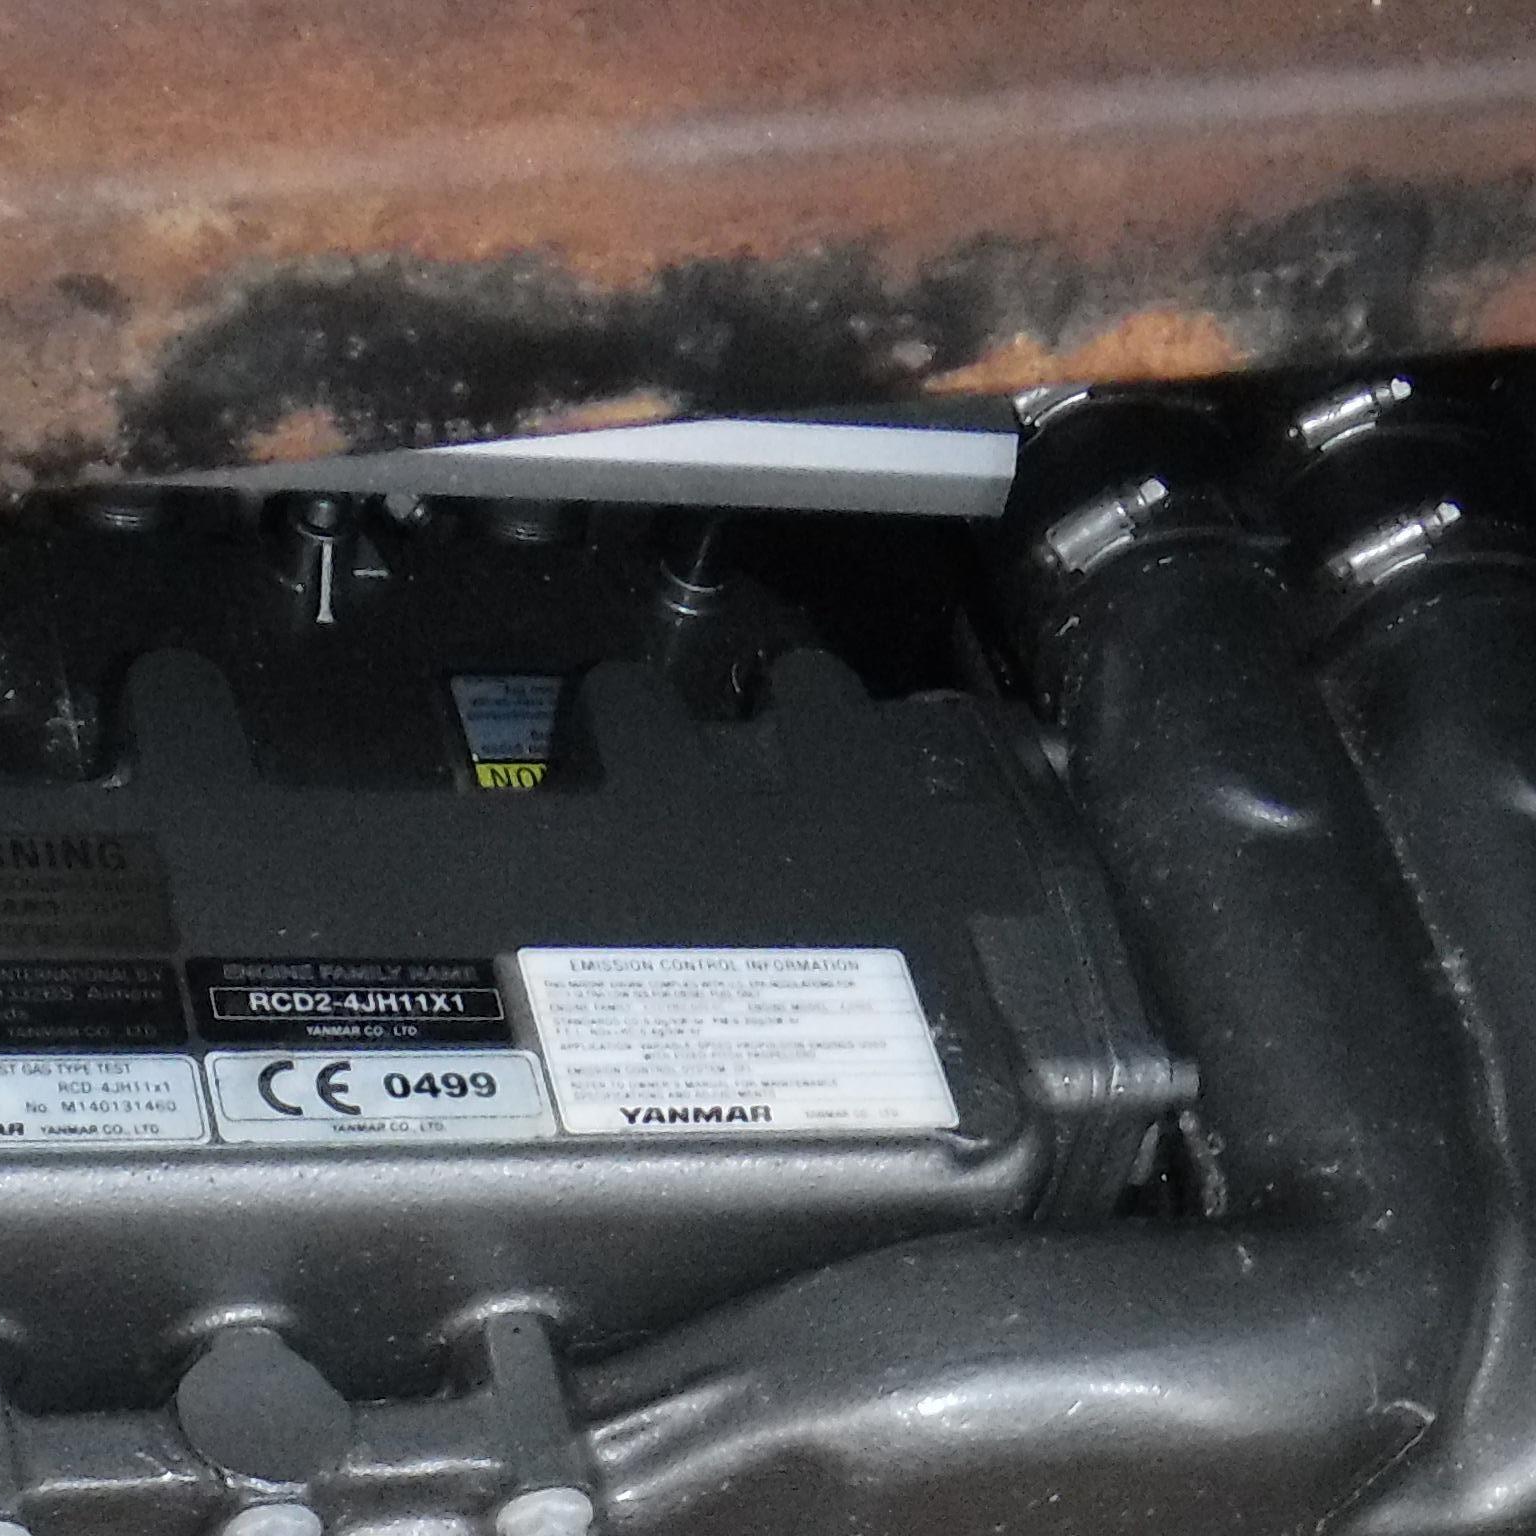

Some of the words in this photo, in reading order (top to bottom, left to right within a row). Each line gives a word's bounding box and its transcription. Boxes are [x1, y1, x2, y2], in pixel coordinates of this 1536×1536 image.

[222, 963, 313, 981] ENGINE
[318, 963, 403, 981] FAMILY
[569, 958, 654, 973] EMISSION
[659, 958, 738, 973] CONTROL
[745, 958, 861, 973] INFORMATION
[248, 992, 465, 1014] RCD2-4JH11X1
[305, 1024, 361, 1037] YANMAR
[21, 1062, 52, 1076] GAS
[56, 1062, 90, 1076] TYPE
[96, 1062, 132, 1076] TEST
[383, 1071, 497, 1099] 0499
[619, 1105, 773, 1125] YANMAR
[40, 1125, 99, 1137] YANMAR
[331, 1121, 386, 1134] YANMAR
